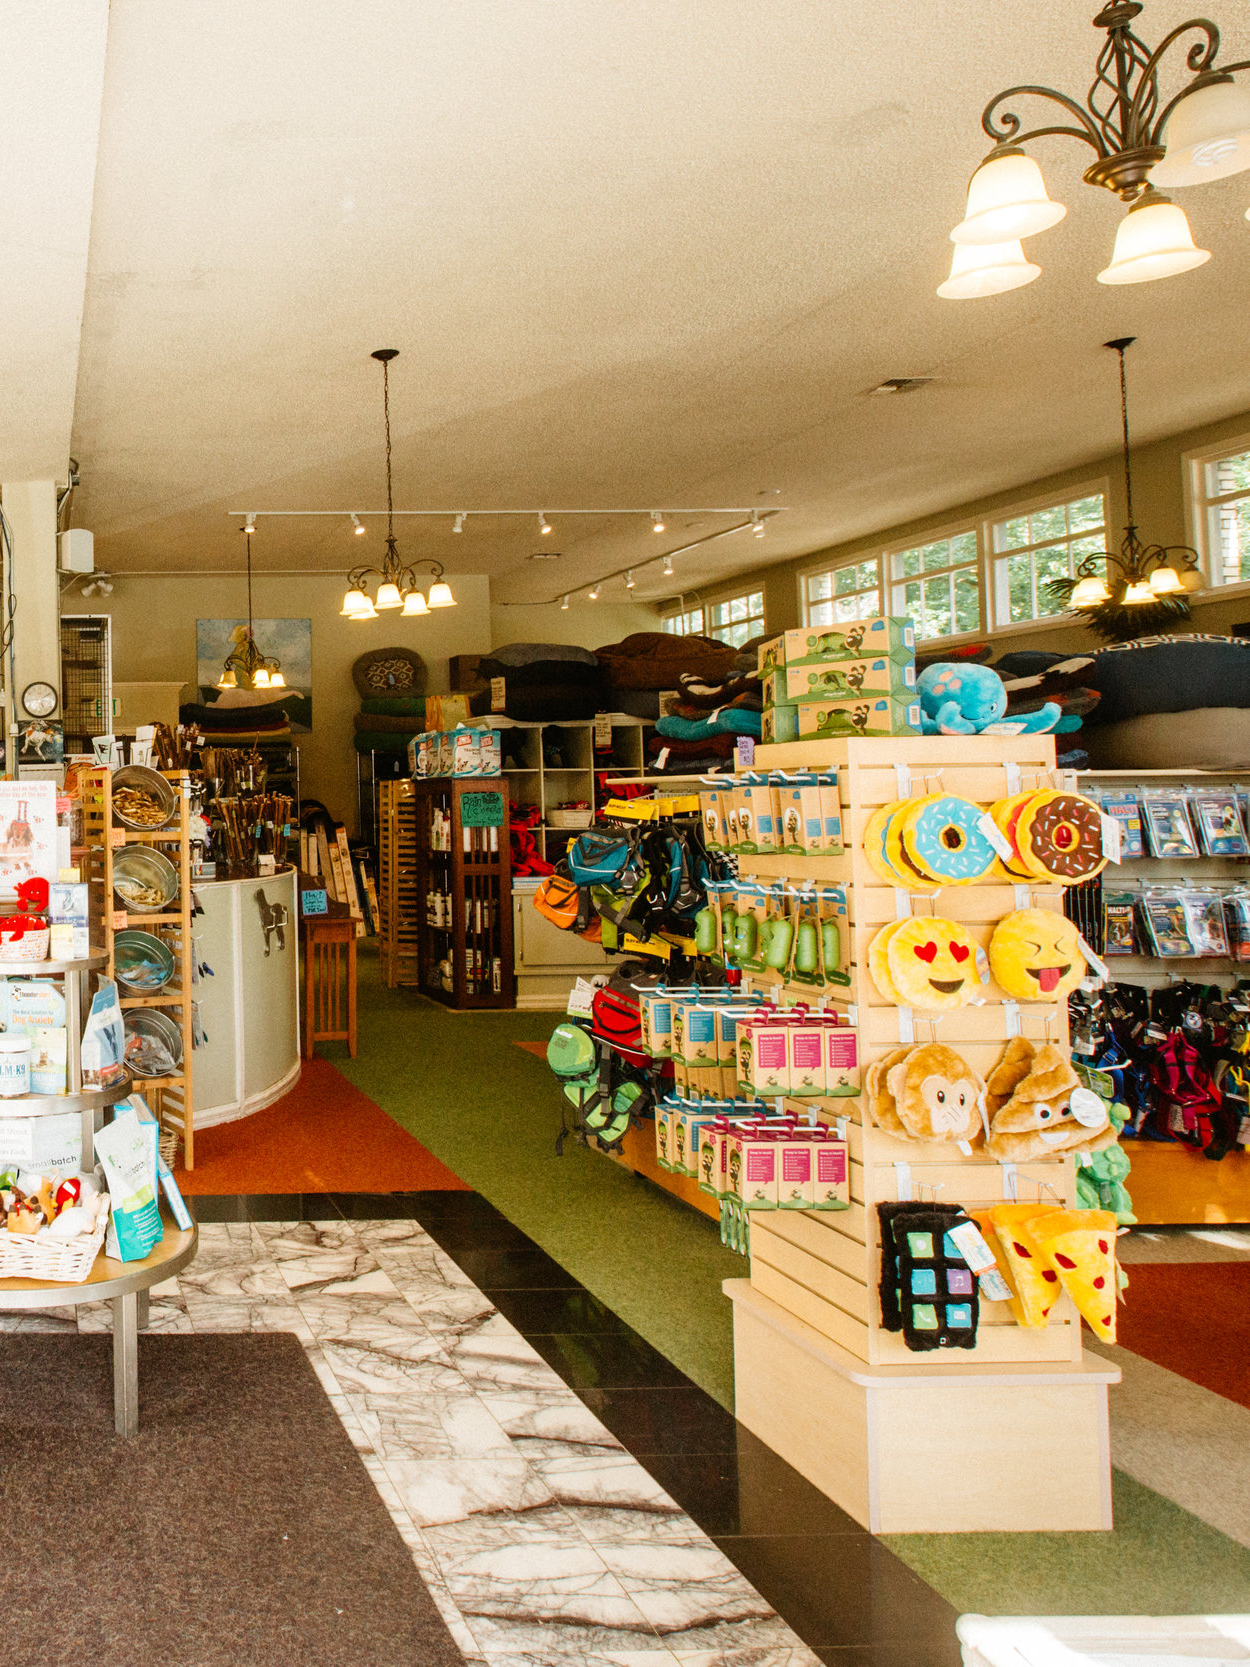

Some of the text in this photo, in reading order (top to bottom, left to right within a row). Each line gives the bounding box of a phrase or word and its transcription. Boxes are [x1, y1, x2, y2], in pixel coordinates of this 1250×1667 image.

[1108, 804, 1138, 815] HALTI
[12, 1015, 54, 1026] Dog Anxiety
[27, 1155, 77, 1170] smallbatch
